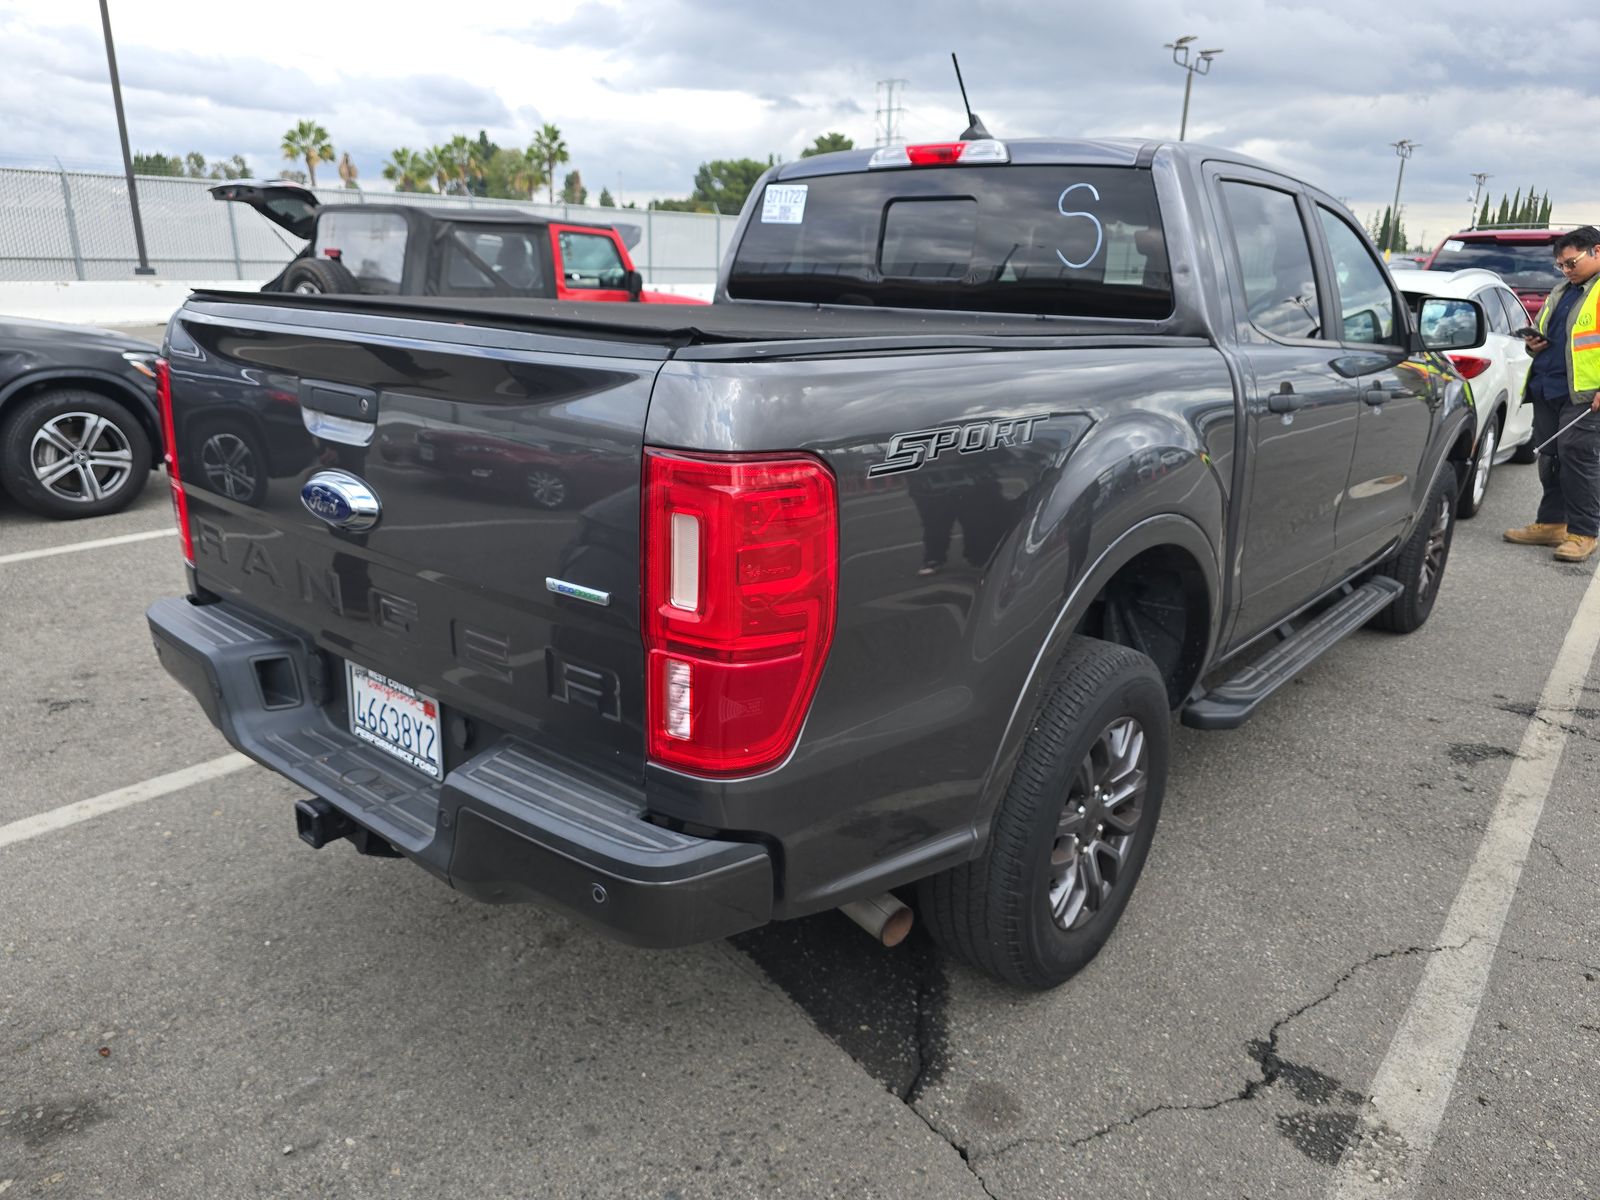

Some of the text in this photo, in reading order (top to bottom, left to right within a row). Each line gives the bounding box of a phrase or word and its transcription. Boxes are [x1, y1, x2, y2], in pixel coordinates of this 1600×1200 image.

[1056, 183, 1102, 269] S
[866, 412, 1051, 479] SPORT
[308, 486, 340, 515] Ford
[196, 515, 621, 723] RANGER
[368, 669, 387, 684] WEST
[387, 678, 416, 698] COVINA
[355, 726, 438, 776] PERFORMANCE FORD
[357, 690, 436, 762] 46638Y2
